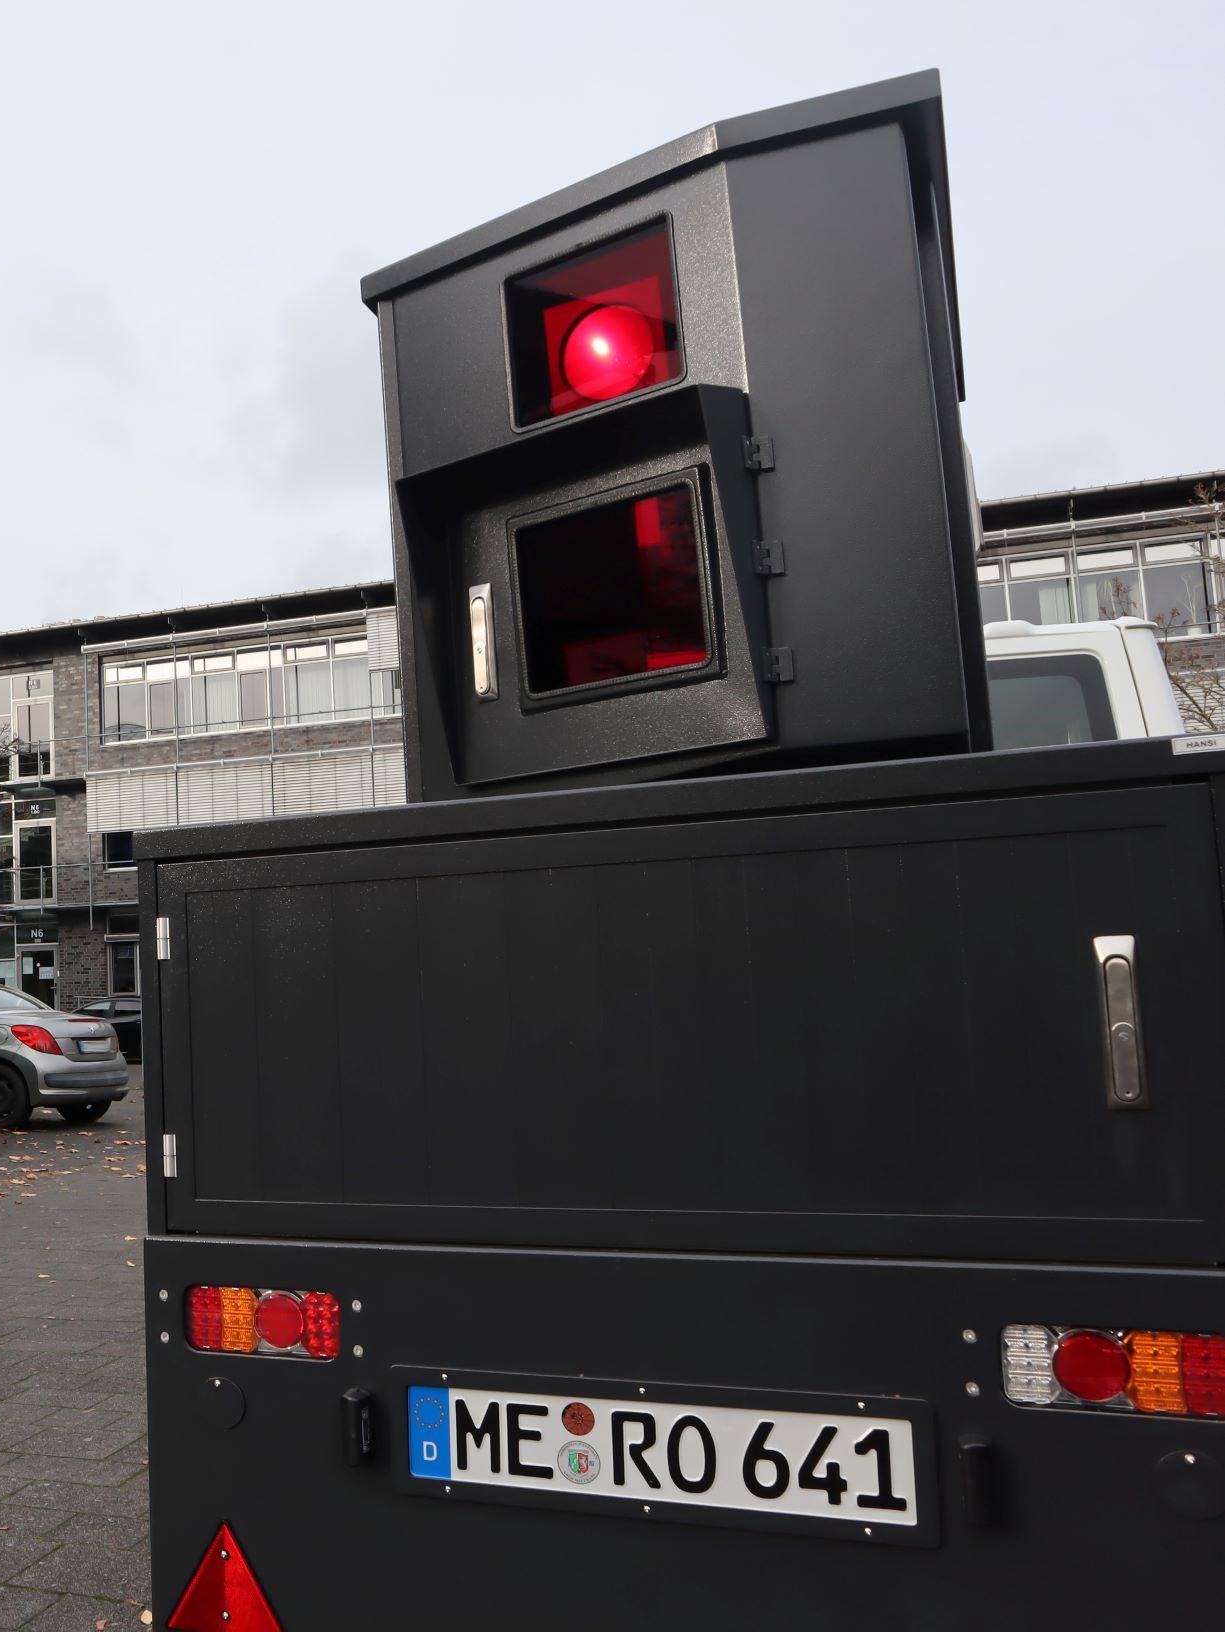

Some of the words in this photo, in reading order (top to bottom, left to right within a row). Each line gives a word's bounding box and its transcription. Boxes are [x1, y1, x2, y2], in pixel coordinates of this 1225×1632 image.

[30, 929, 44, 938] N6
[422, 1440, 438, 1462] D
[454, 1398, 555, 1480] ME
[611, 1409, 717, 1495] RO
[742, 1420, 908, 1512] 641
